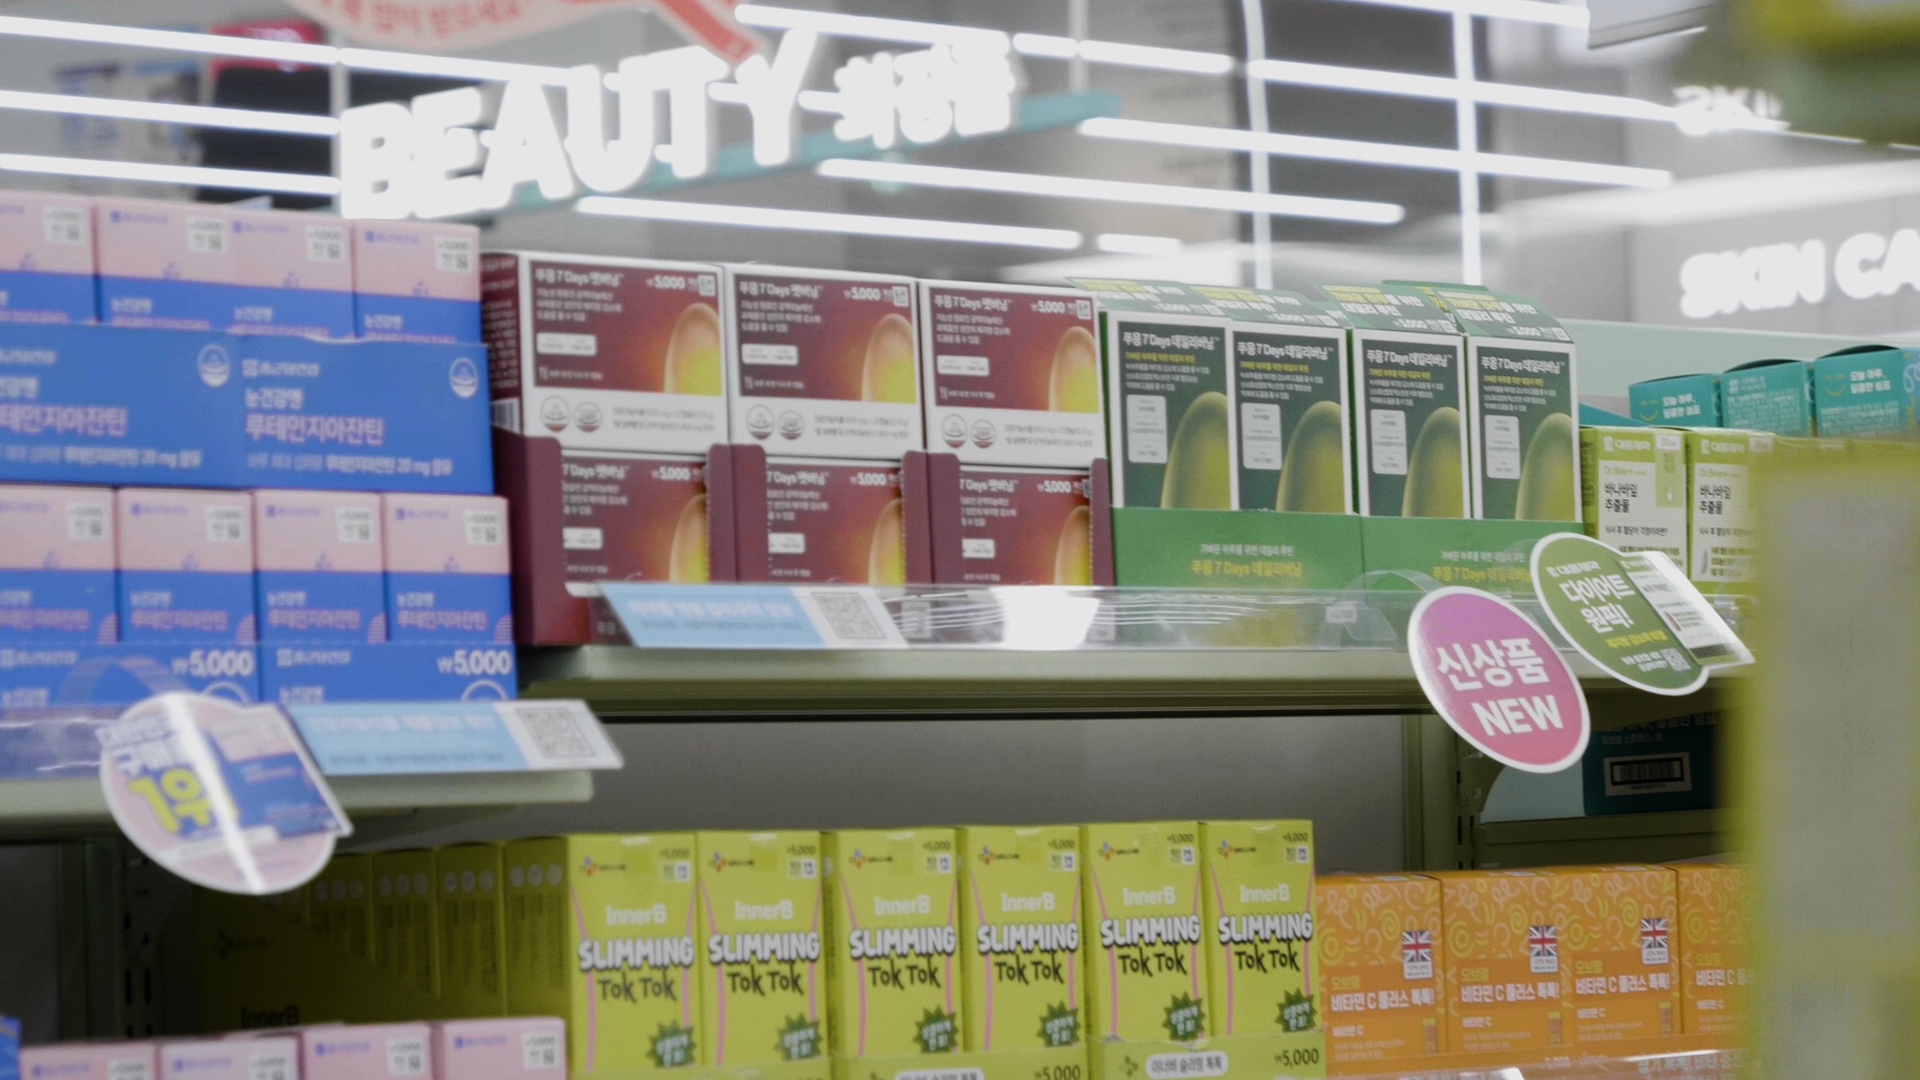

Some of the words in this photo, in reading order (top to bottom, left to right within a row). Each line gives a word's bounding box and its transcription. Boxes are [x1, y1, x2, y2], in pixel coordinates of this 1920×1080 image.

[340, 24, 818, 219] BEAUTY
[1680, 240, 1826, 318] SKIN
[767, 284, 790, 298] Days
[1149, 334, 1170, 349] Days
[1263, 344, 1285, 358] Days
[1390, 352, 1409, 365] Days
[1504, 359, 1522, 372] Days
[245, 413, 386, 446] 루테인지아잔틴
[1214, 561, 1221, 574] 7
[1224, 561, 1250, 577] Days
[1453, 567, 1460, 580] 7
[1462, 567, 1486, 582] Days
[1559, 572, 1636, 604] 다이어트
[1581, 602, 1634, 633] 원픽!
[171, 650, 254, 676] ₩5,000
[437, 650, 513, 677] ₩5,000
[1438, 637, 1550, 692] 신상품
[1470, 693, 1564, 737] NEW
[1001, 891, 1055, 913] InnerB
[1122, 886, 1176, 906] InnerB
[1239, 883, 1290, 904] InnerB
[605, 903, 667, 927] InnerB
[734, 900, 794, 922] InnerB
[874, 894, 931, 917] InnerB
[977, 923, 1079, 955] SLIMMING
[1100, 914, 1200, 948] SLIMMING
[1218, 912, 1313, 944] SLIMMING
[578, 936, 695, 971] SLIMMING
[708, 932, 820, 964] SLIMMING
[849, 925, 956, 960] SLIMMING
[1576, 977, 1607, 995] 비타민
[1608, 976, 1617, 993] C
[1618, 975, 1648, 993] 플러스
[1649, 972, 1670, 990] 톡톡!
[1695, 969, 1725, 987] 비타민
[1726, 968, 1735, 984] C
[1330, 993, 1364, 1012] 비타민
[1366, 992, 1376, 1009] C
[1378, 990, 1409, 1009] 플러스
[1410, 987, 1435, 1006] 톡톡!
[1461, 985, 1493, 1004] 비타민
[1495, 985, 1504, 1001] C
[1505, 983, 1536, 1002] 플러스
[1536, 981, 1560, 999] 톡톡!
[1462, 1017, 1484, 1027] 비타민
[1485, 1016, 1492, 1026] C
[1577, 1008, 1598, 1019] 비타민
[1599, 1007, 1606, 1017] C
[1332, 1026, 1356, 1037] 비타민
[1356, 1025, 1363, 1036] C
[1275, 1049, 1320, 1067] ₩5,000
